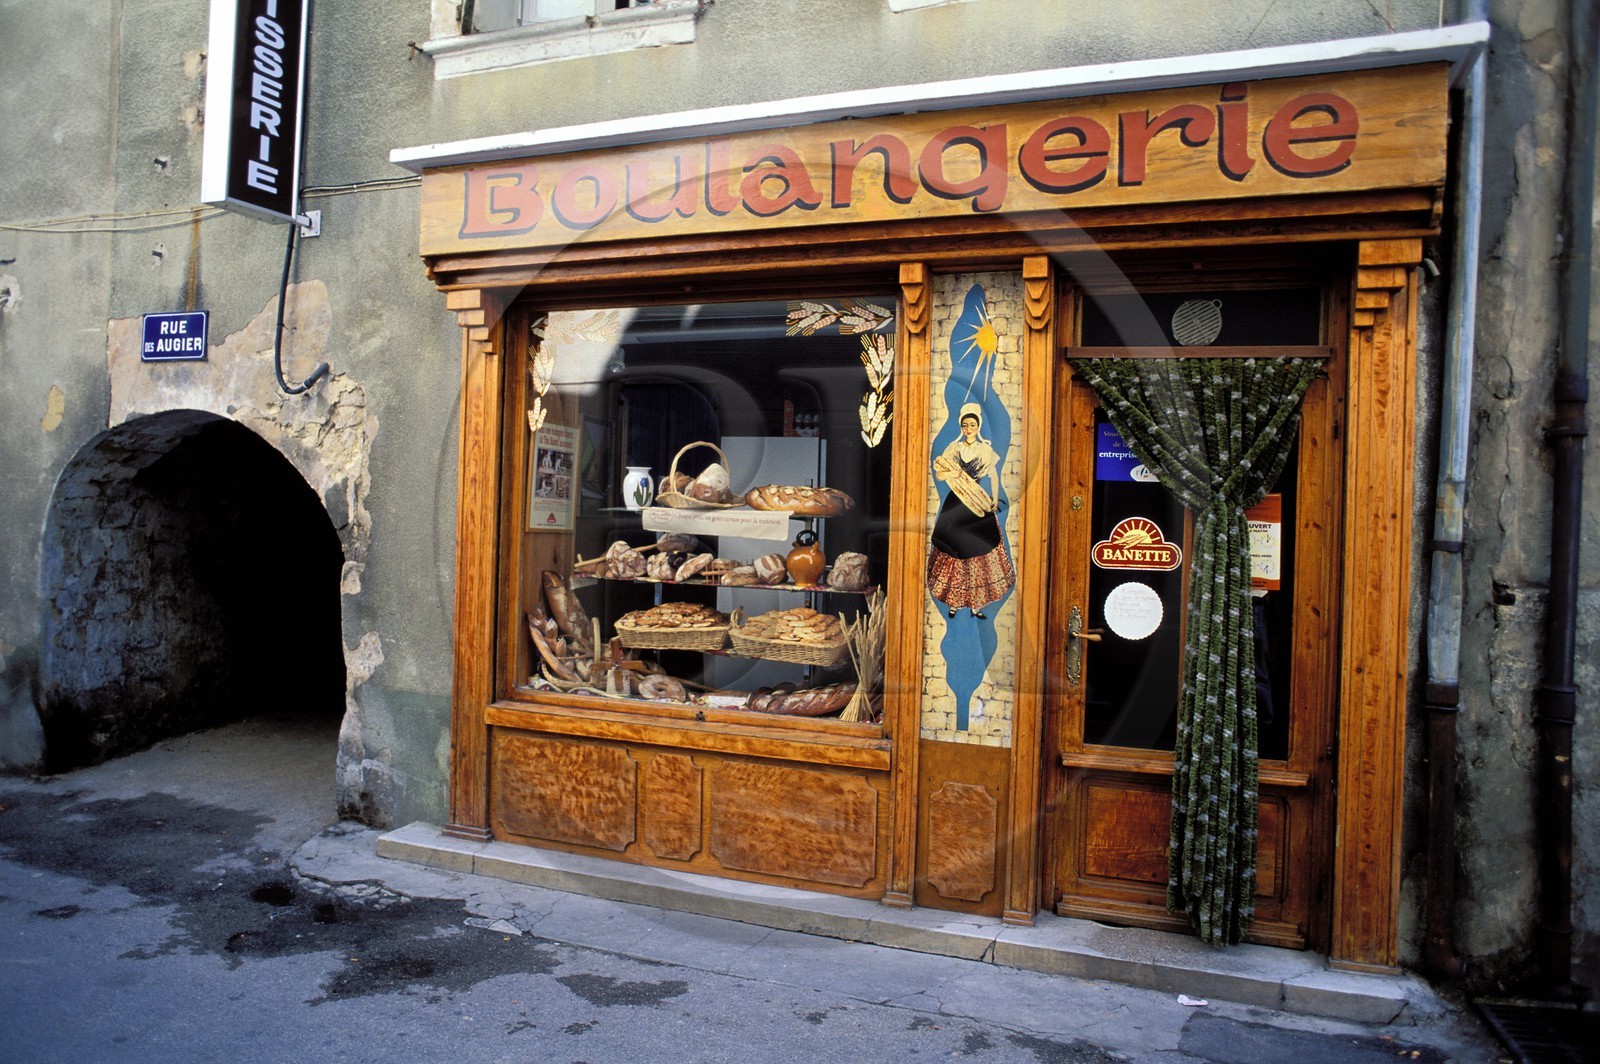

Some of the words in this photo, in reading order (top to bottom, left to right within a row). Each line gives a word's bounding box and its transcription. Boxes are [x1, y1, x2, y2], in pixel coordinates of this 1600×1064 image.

[457, 83, 1360, 239] Boulangerie
[160, 320, 188, 334] RUE
[144, 342, 155, 352] DES
[156, 337, 202, 352] AUGIER
[1102, 548, 1171, 562] BANETTE
